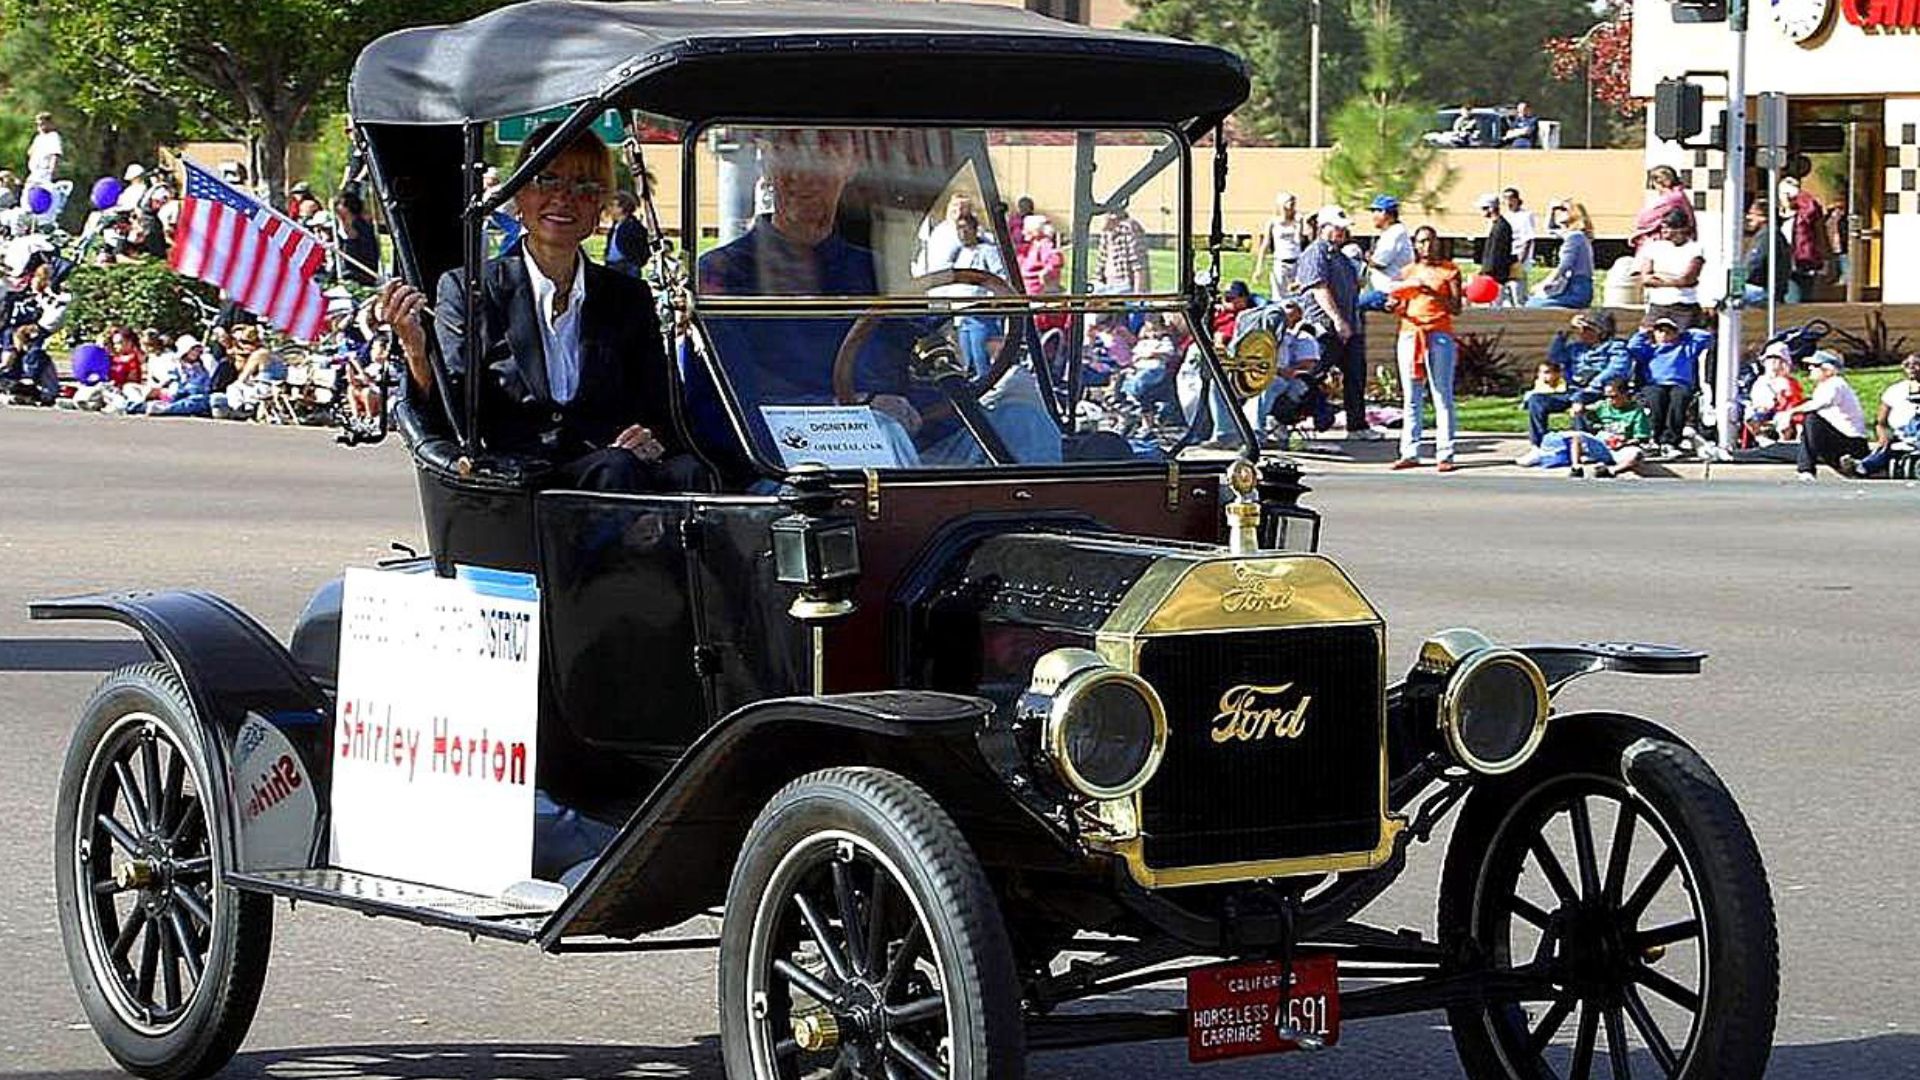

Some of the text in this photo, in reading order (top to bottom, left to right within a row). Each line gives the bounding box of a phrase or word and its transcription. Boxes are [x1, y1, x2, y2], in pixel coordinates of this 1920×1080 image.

[810, 422, 869, 432] DIGNITARY
[1220, 573, 1297, 613] Ford
[478, 608, 531, 663] DISTRICT
[1211, 681, 1312, 743] Ford
[341, 698, 420, 783] Shirley
[431, 716, 527, 786] Horton
[1193, 1003, 1269, 1029] HORSELESS
[1201, 1023, 1263, 1047] CARRIAGE
